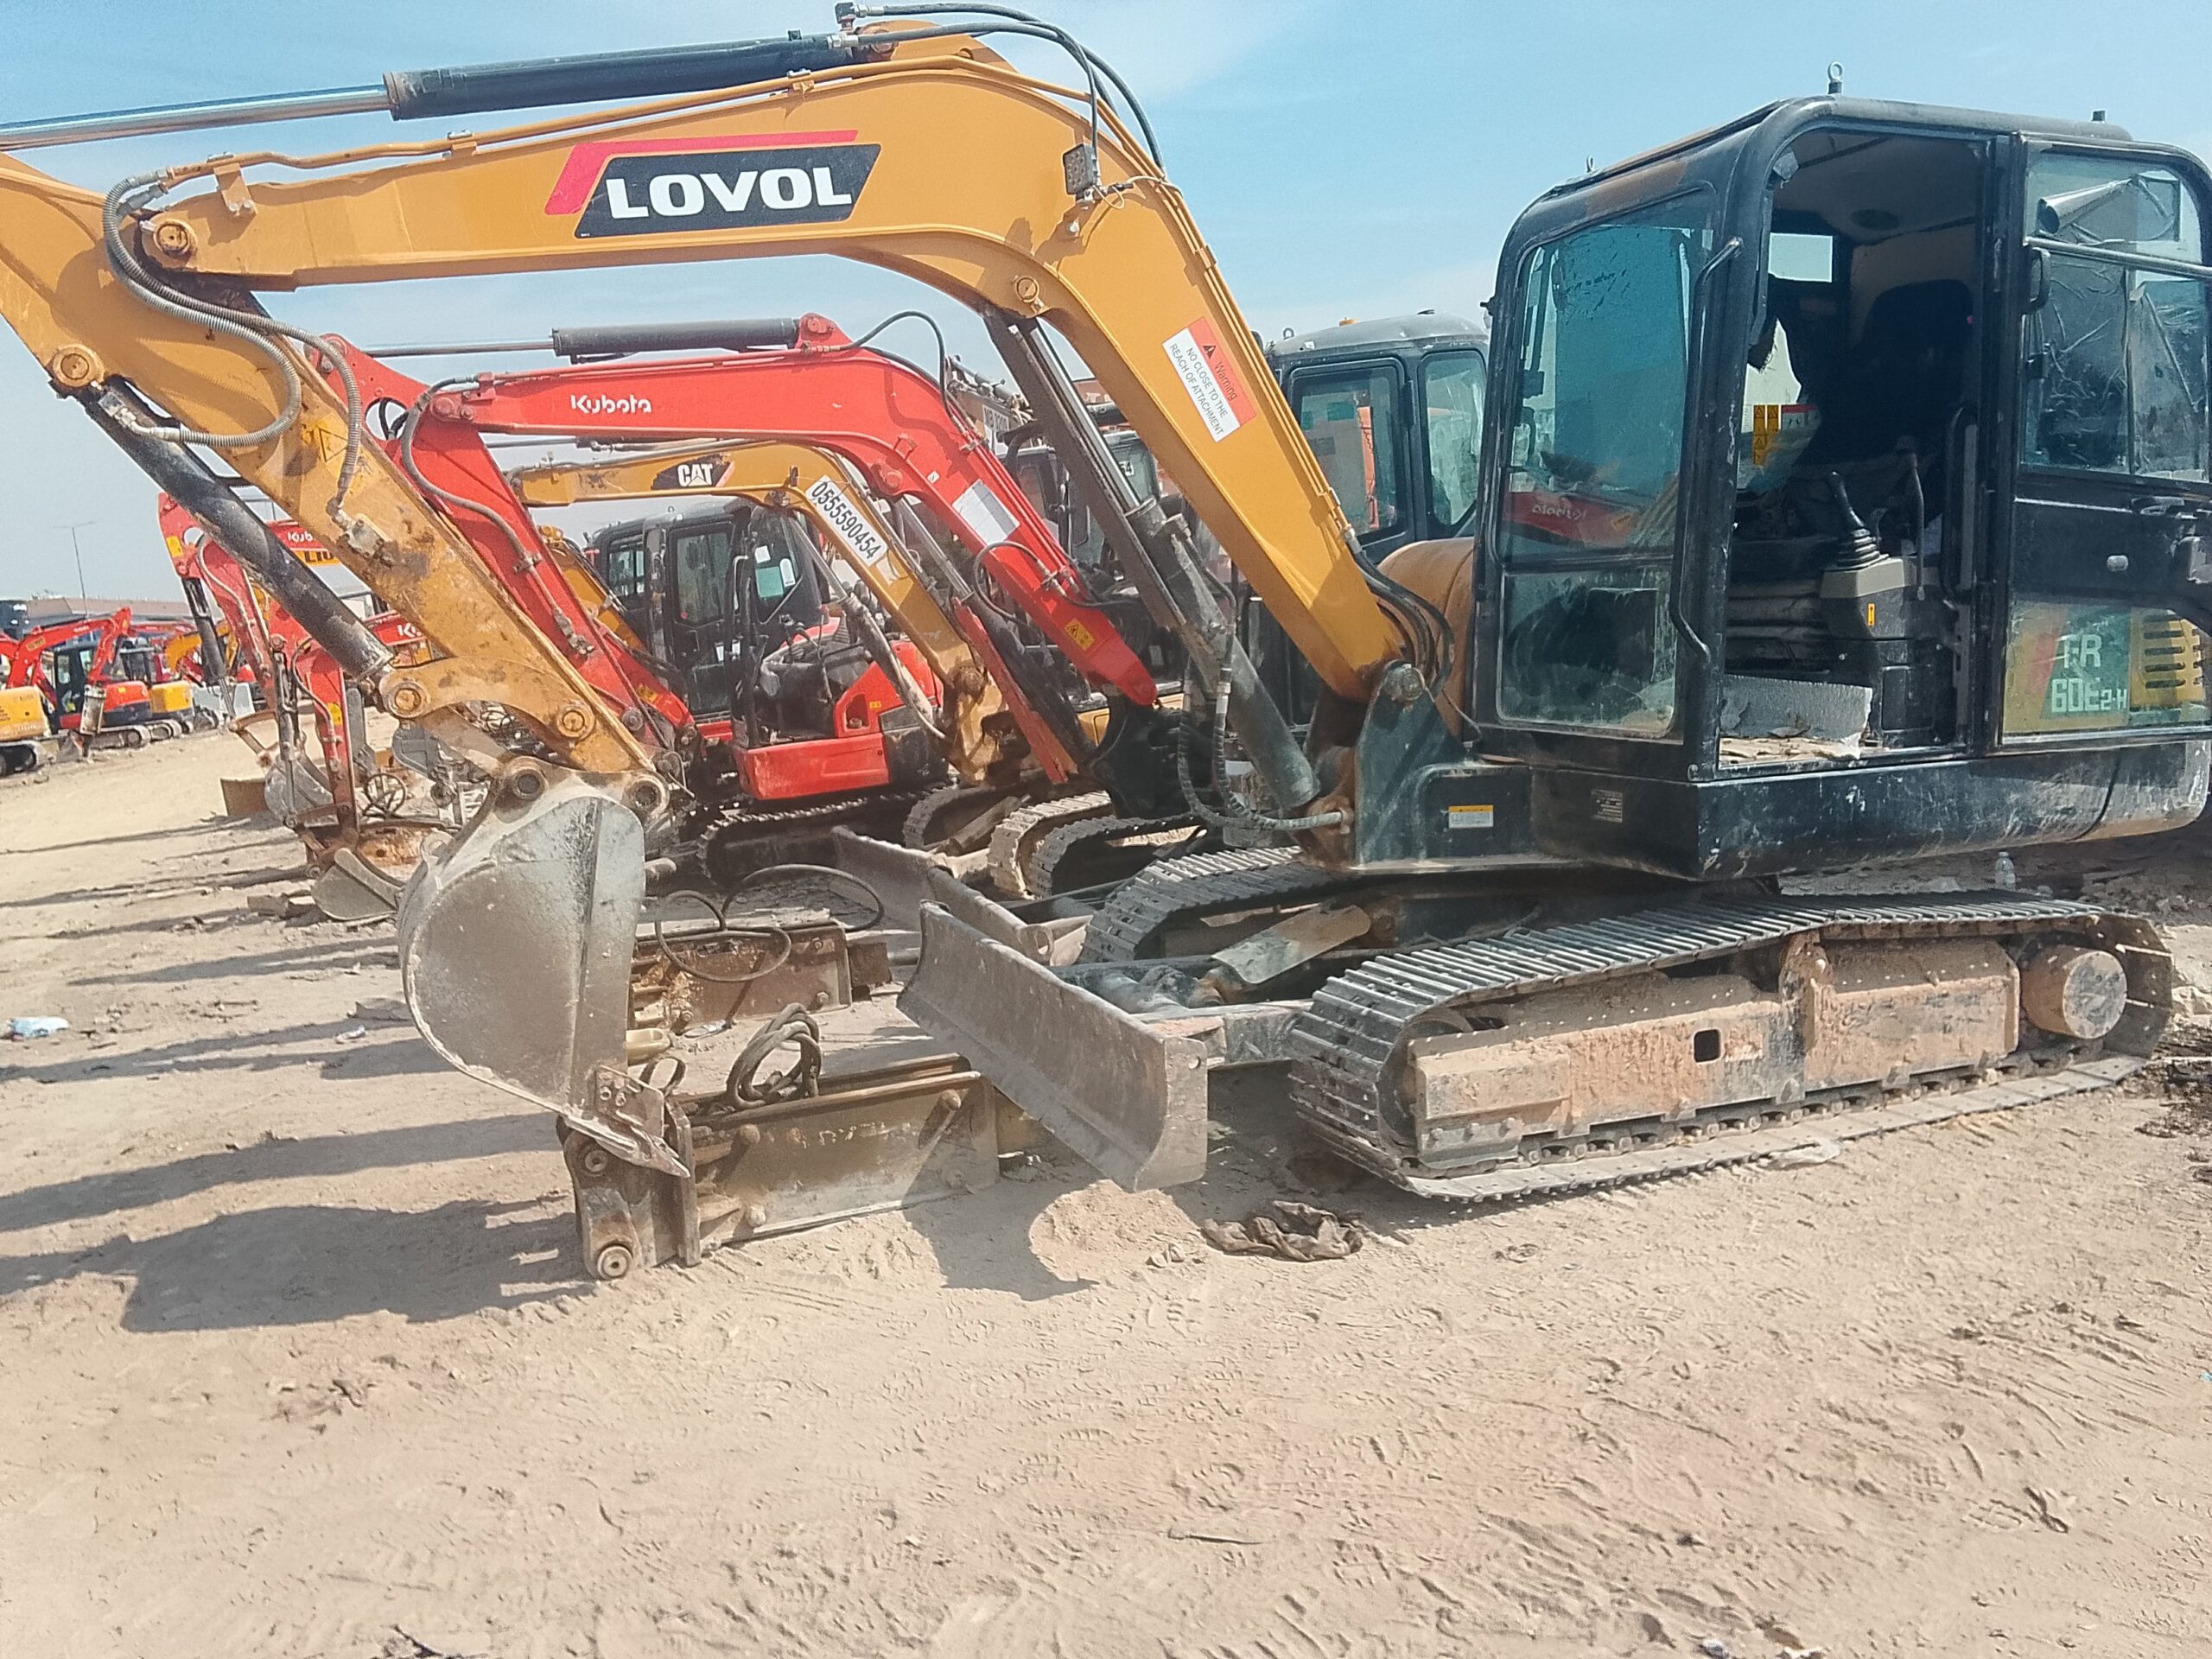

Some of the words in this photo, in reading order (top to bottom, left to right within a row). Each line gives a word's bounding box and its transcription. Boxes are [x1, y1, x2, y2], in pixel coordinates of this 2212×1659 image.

[606, 167, 852, 219] LOVOL
[1185, 347, 1198, 361] NO
[1193, 361, 1213, 389] CLOSE
[1215, 361, 1238, 402] Warning
[1169, 343, 1190, 373] REACH
[1185, 372, 1197, 384] OF
[1192, 385, 1224, 435] ATTACHMENT
[1208, 387, 1219, 401] TO
[570, 394, 652, 414] Kubota
[1213, 397, 1228, 418] THE
[677, 463, 714, 487] CAT
[811, 481, 882, 560] 0555590454
[287, 531, 315, 543] Kub
